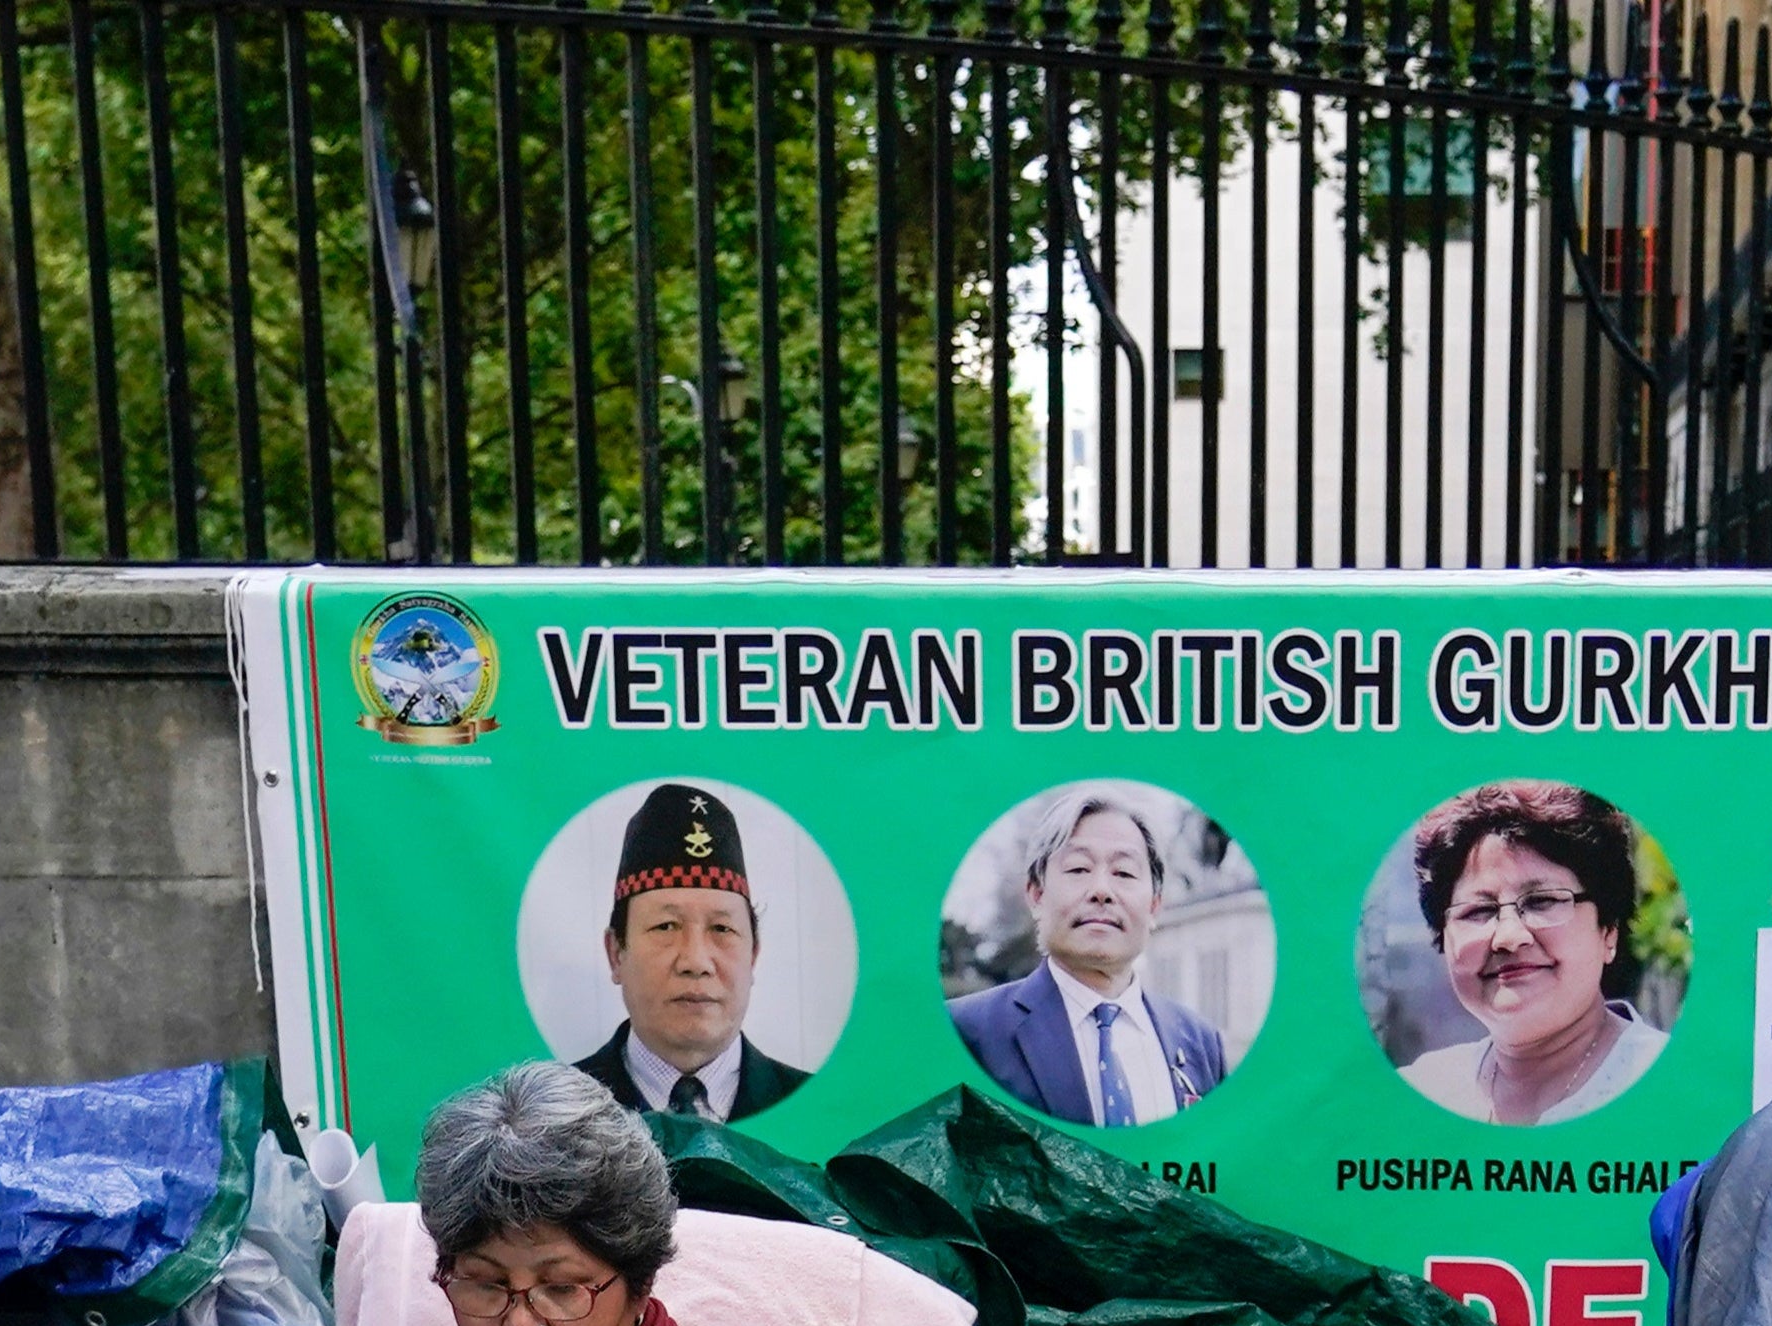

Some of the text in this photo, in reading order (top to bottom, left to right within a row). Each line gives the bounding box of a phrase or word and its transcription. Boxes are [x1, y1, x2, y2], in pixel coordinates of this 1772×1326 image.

[543, 632, 977, 727] VETERAN
[1017, 633, 1395, 728] BRITISH
[1336, 1159, 1473, 1192] PUSHPA
[1483, 1160, 1577, 1193] RANA
